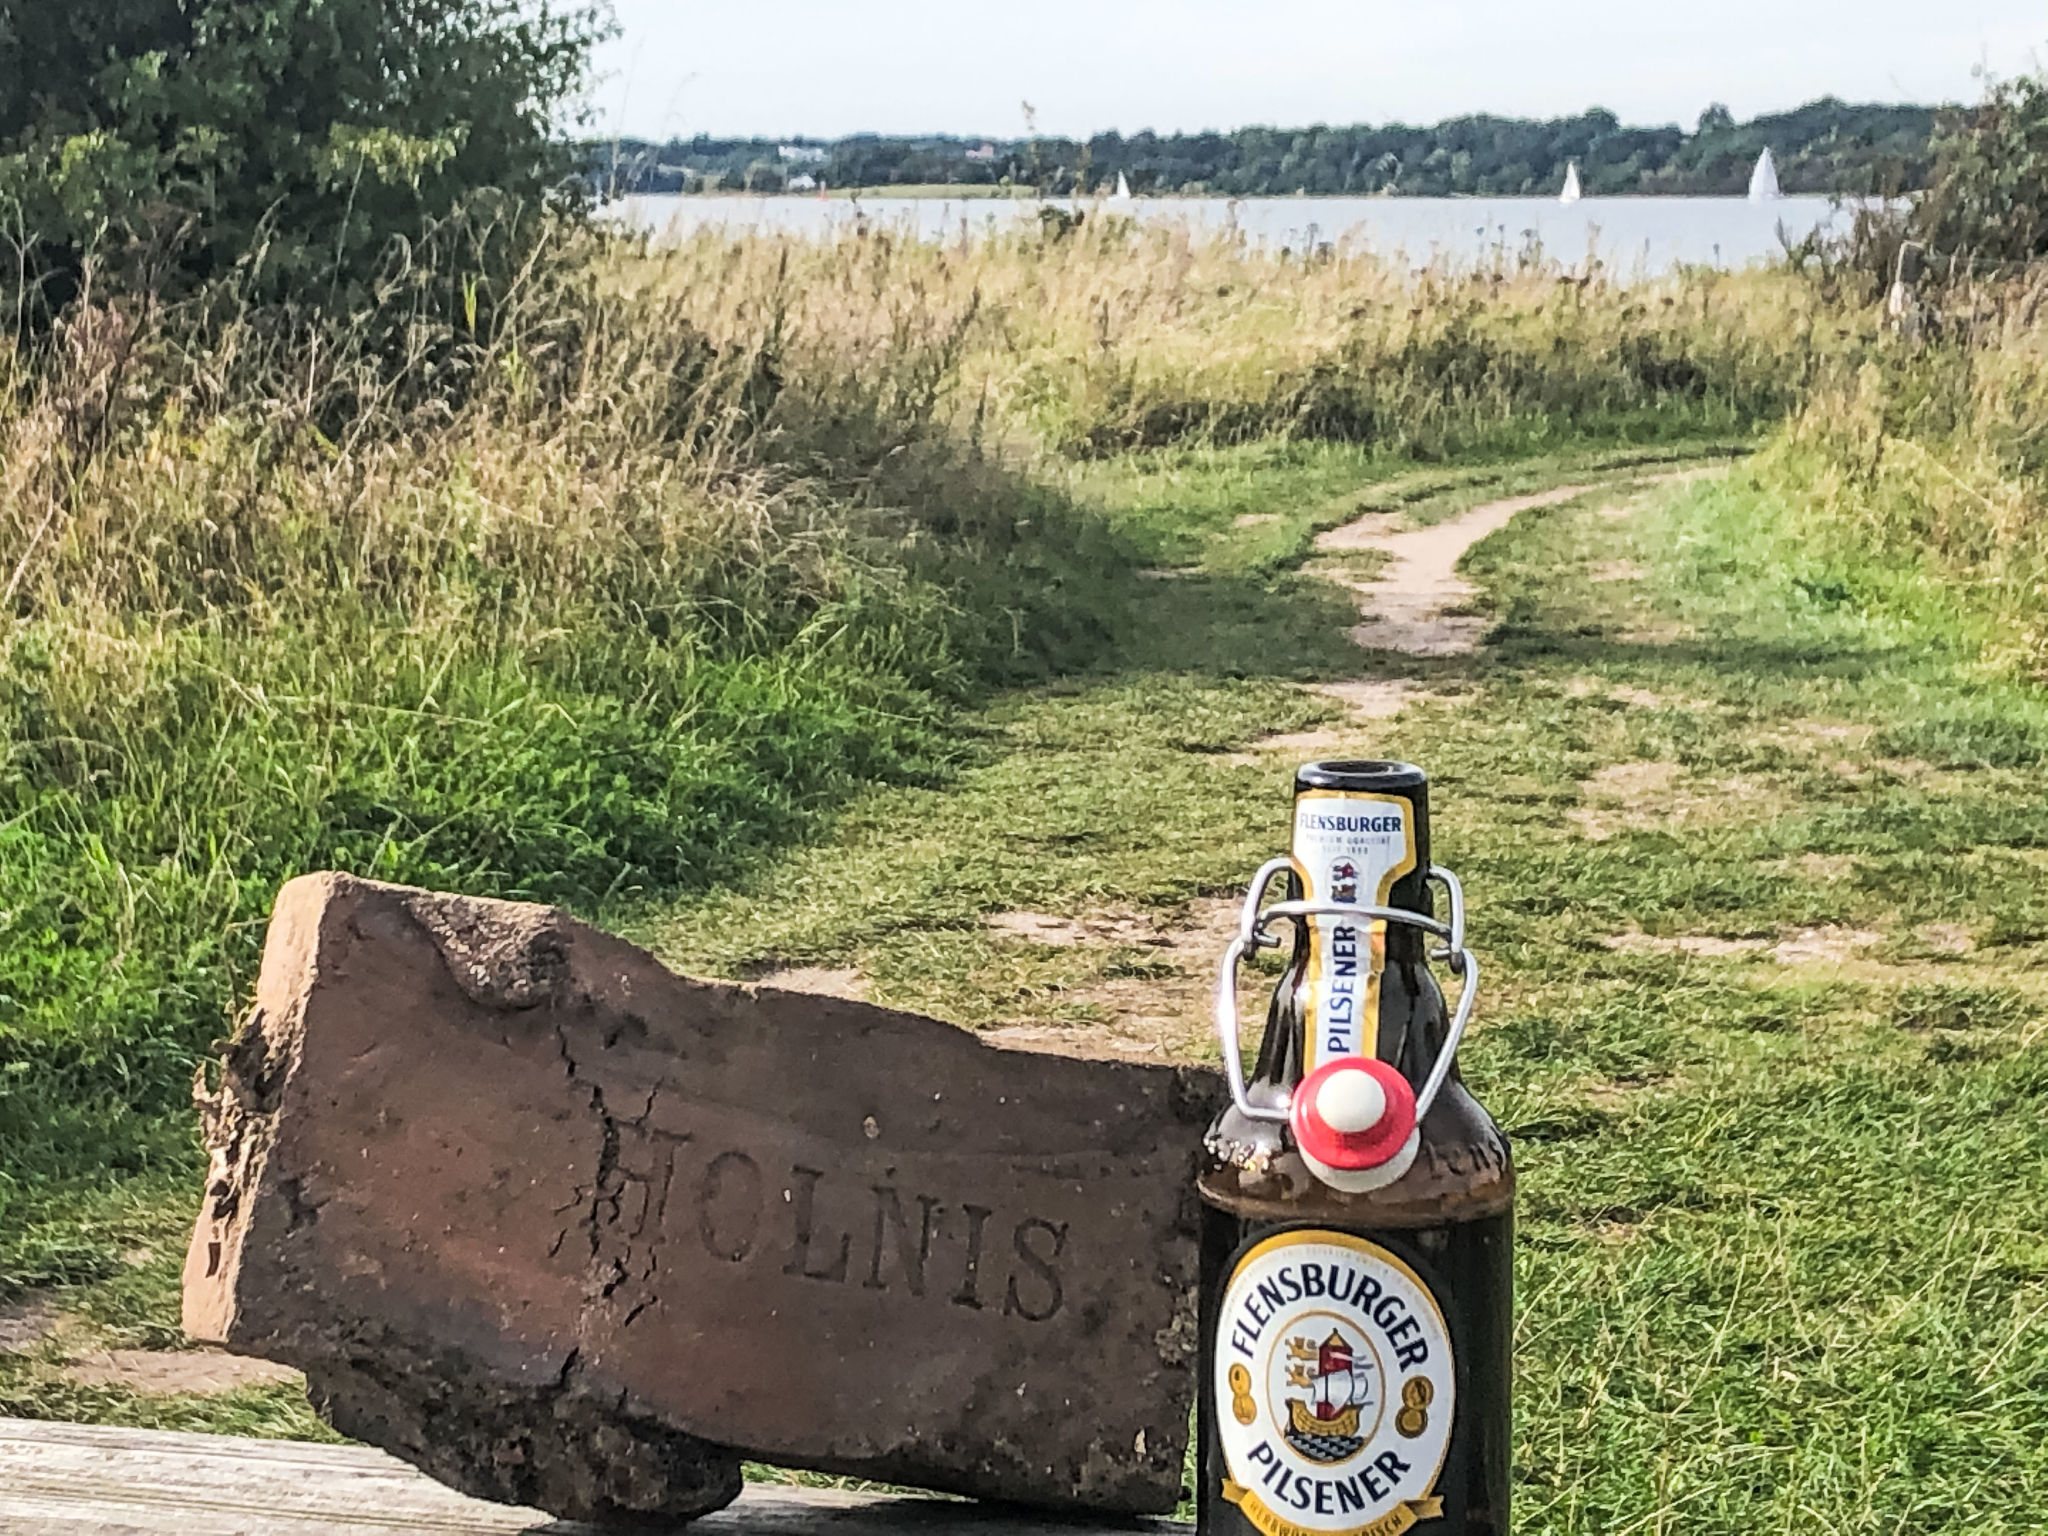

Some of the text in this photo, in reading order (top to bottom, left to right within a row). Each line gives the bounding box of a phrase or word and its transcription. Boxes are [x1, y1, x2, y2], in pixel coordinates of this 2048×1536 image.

[1300, 813, 1402, 832] FLENSBURGER
[1327, 925, 1357, 1053] PILSENER
[594, 1117, 1070, 1322] HOLNIS
[1231, 1263, 1429, 1373] FLENSBURGER
[1247, 1440, 1411, 1515] PILSENER
